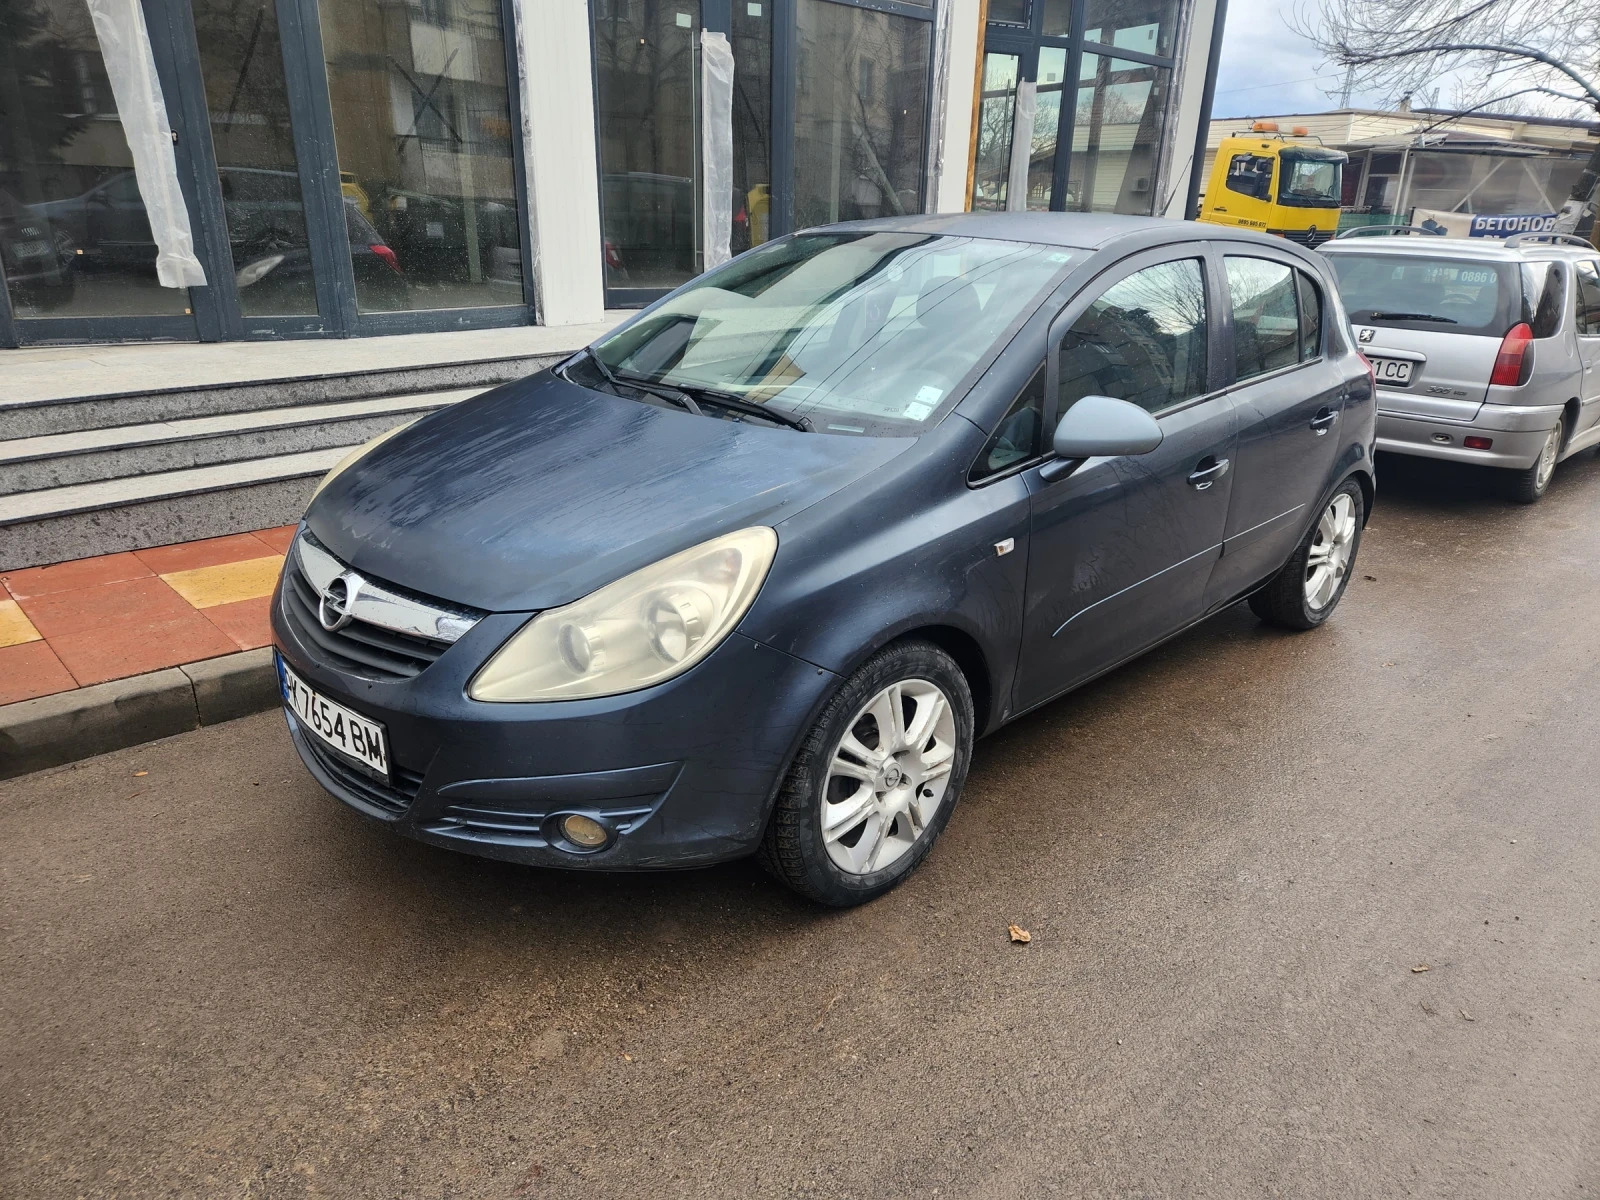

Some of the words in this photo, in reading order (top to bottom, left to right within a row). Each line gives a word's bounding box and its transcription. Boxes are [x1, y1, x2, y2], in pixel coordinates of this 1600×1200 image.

[1461, 271, 1487, 283] 0886
[1385, 362, 1409, 379] CC
[1426, 385, 1453, 395] 306
[300, 685, 348, 748] 7654
[348, 717, 384, 768] BM
